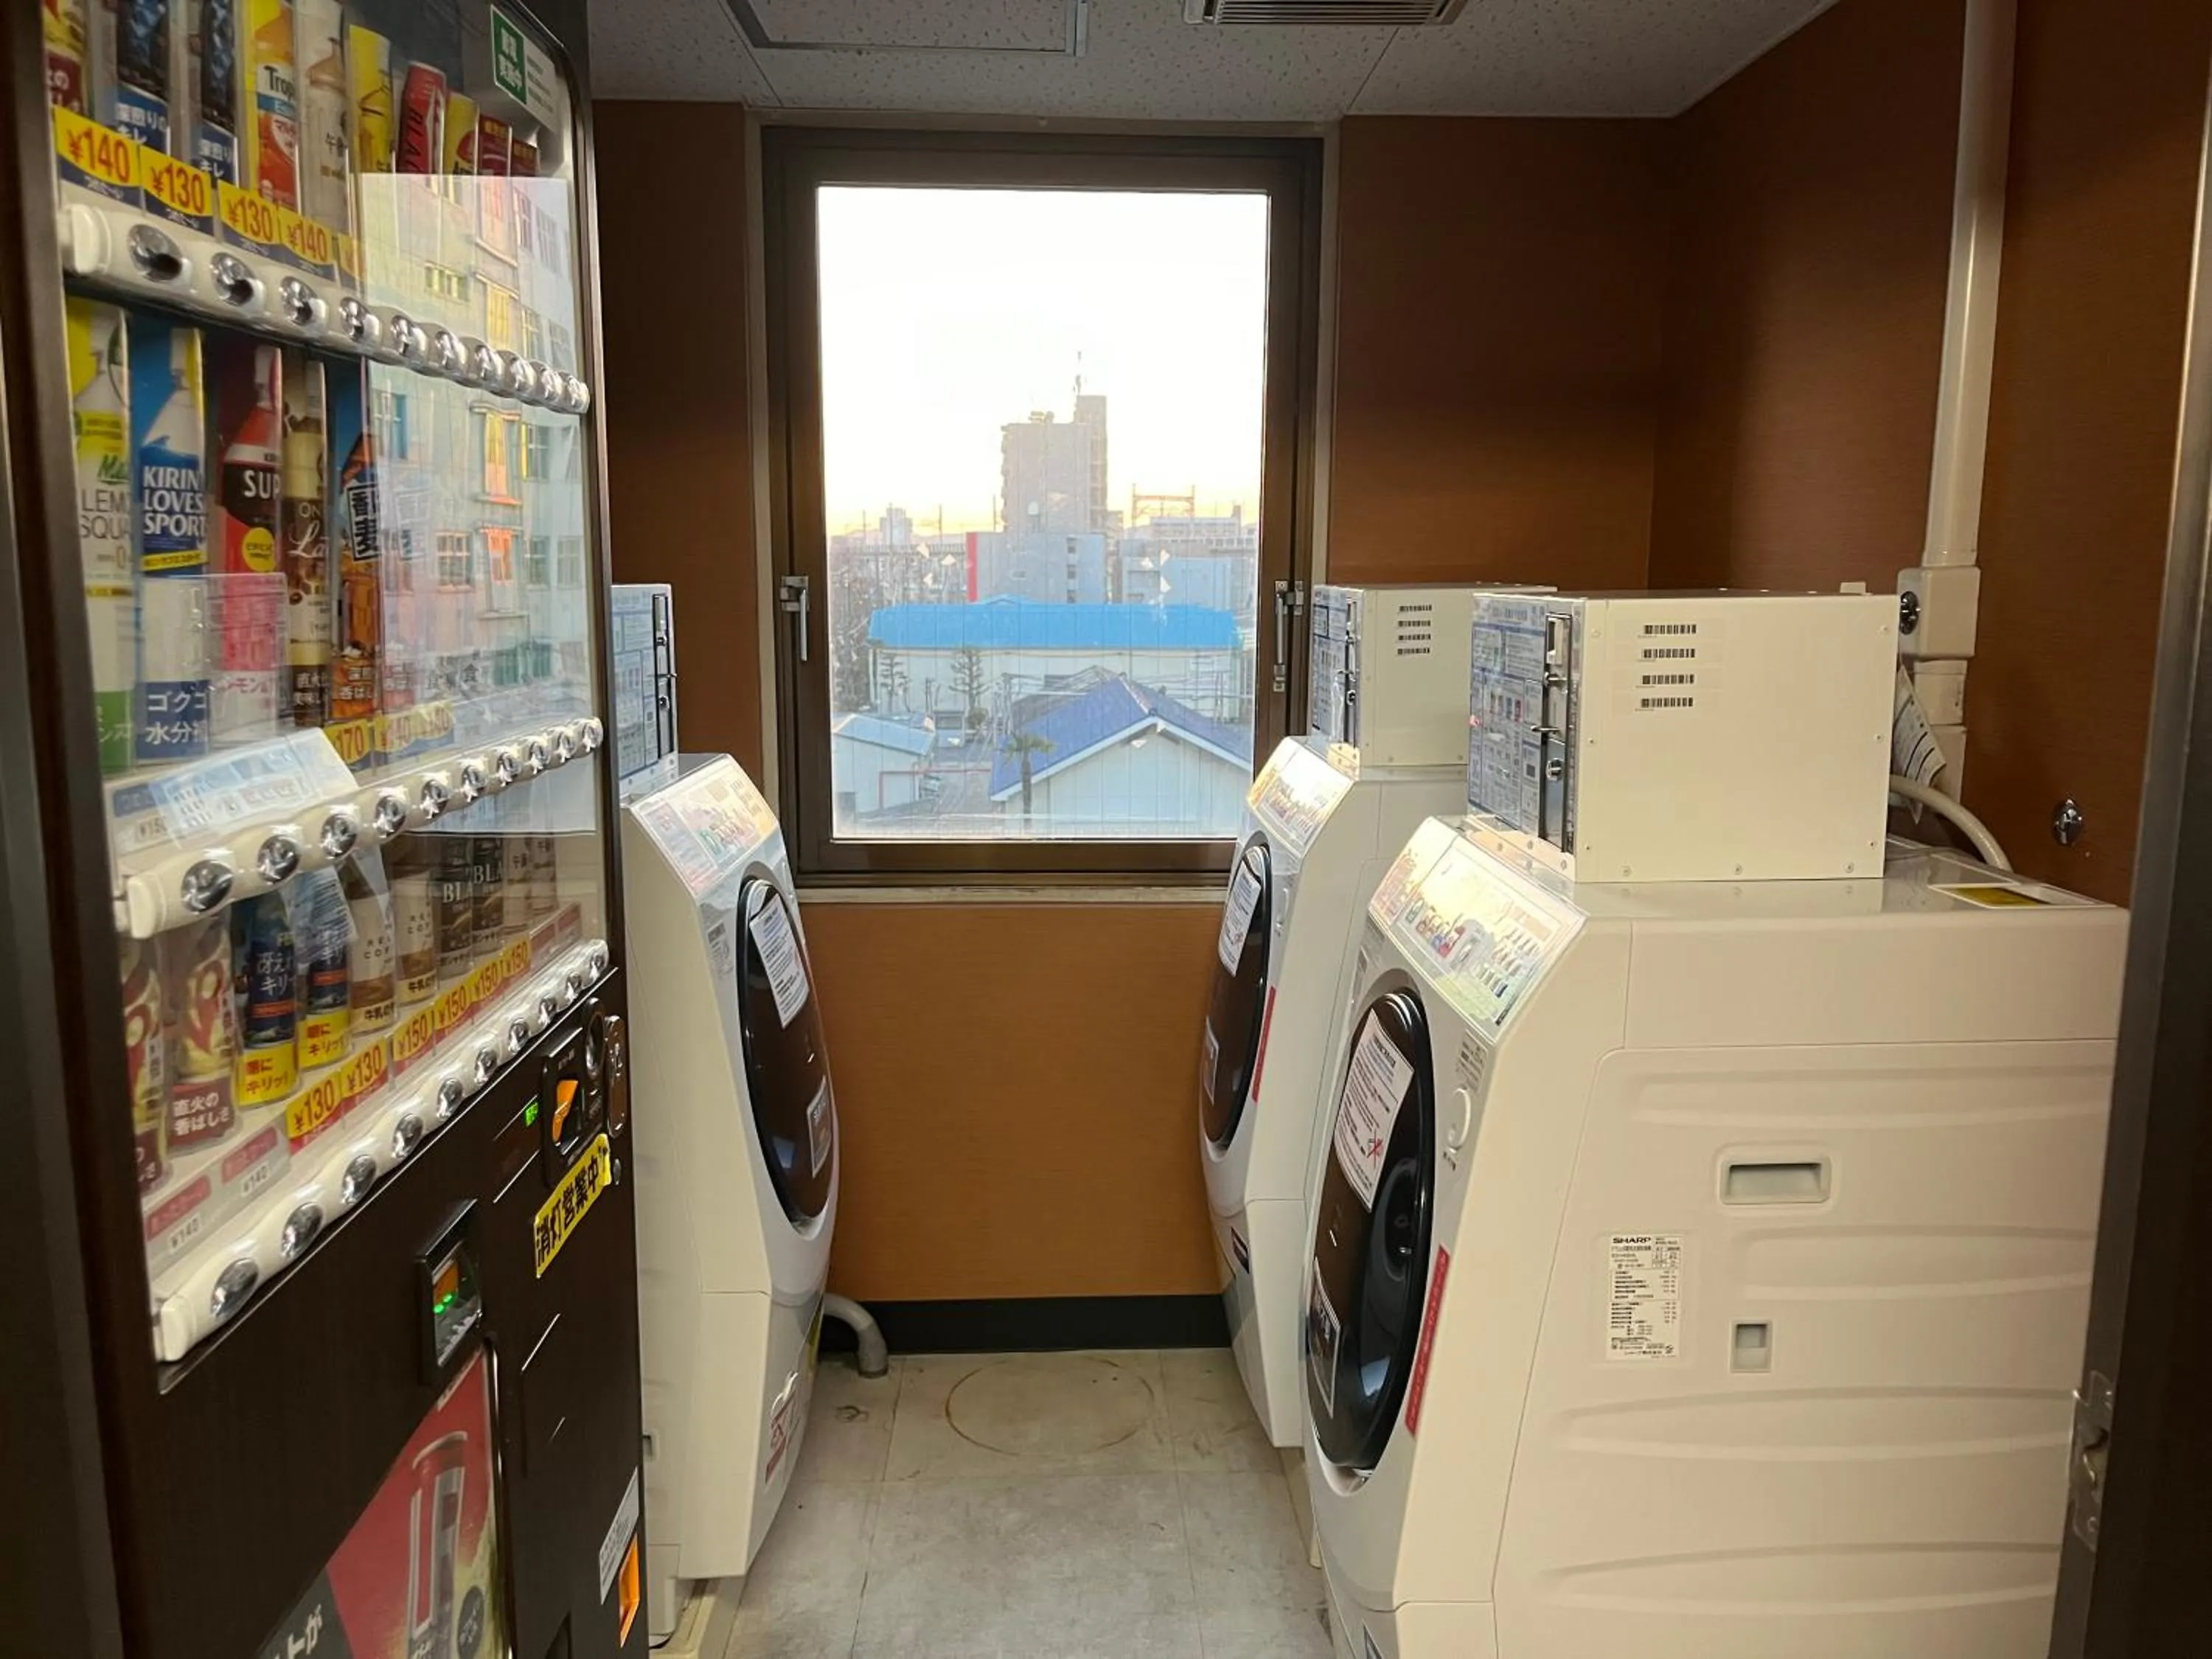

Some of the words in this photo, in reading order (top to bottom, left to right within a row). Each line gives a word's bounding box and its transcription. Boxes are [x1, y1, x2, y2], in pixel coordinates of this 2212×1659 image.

[66, 127, 131, 183] ¥140
[150, 162, 205, 213] ¥130
[227, 196, 274, 243] ¥130
[288, 219, 327, 262] ¥140
[143, 466, 202, 490] KIRIN
[143, 489, 204, 514] LOVES
[475, 961, 498, 995] ¥150
[438, 985, 467, 1024] ¥150
[398, 1014, 428, 1054] ¥150
[347, 1044, 382, 1091] ¥130
[294, 1079, 334, 1132] ¥130
